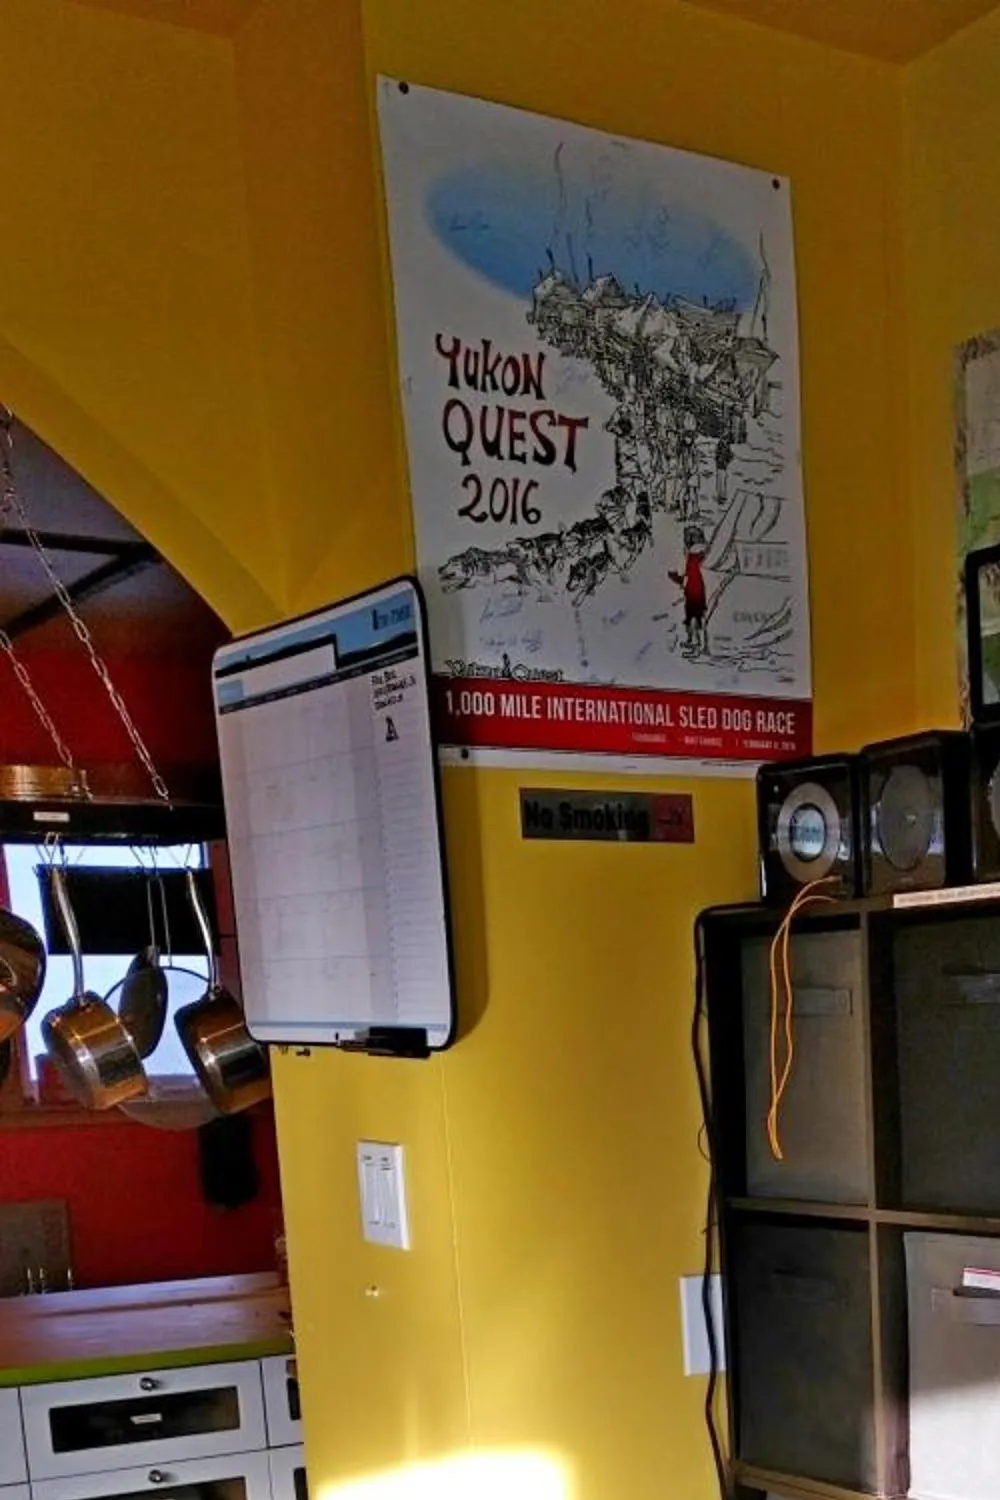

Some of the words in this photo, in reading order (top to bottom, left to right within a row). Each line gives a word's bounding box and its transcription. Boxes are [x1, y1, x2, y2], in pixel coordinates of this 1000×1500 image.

[442, 398, 590, 473] QUEST
[457, 473, 541, 525] 2016
[445, 691, 495, 717] 1,000
[500, 693, 541, 719] MILE
[547, 697, 675, 728] INTERNATIONAL
[679, 706, 717, 730] SLED
[721, 709, 752, 732] DOG
[756, 711, 796, 735] RACE
